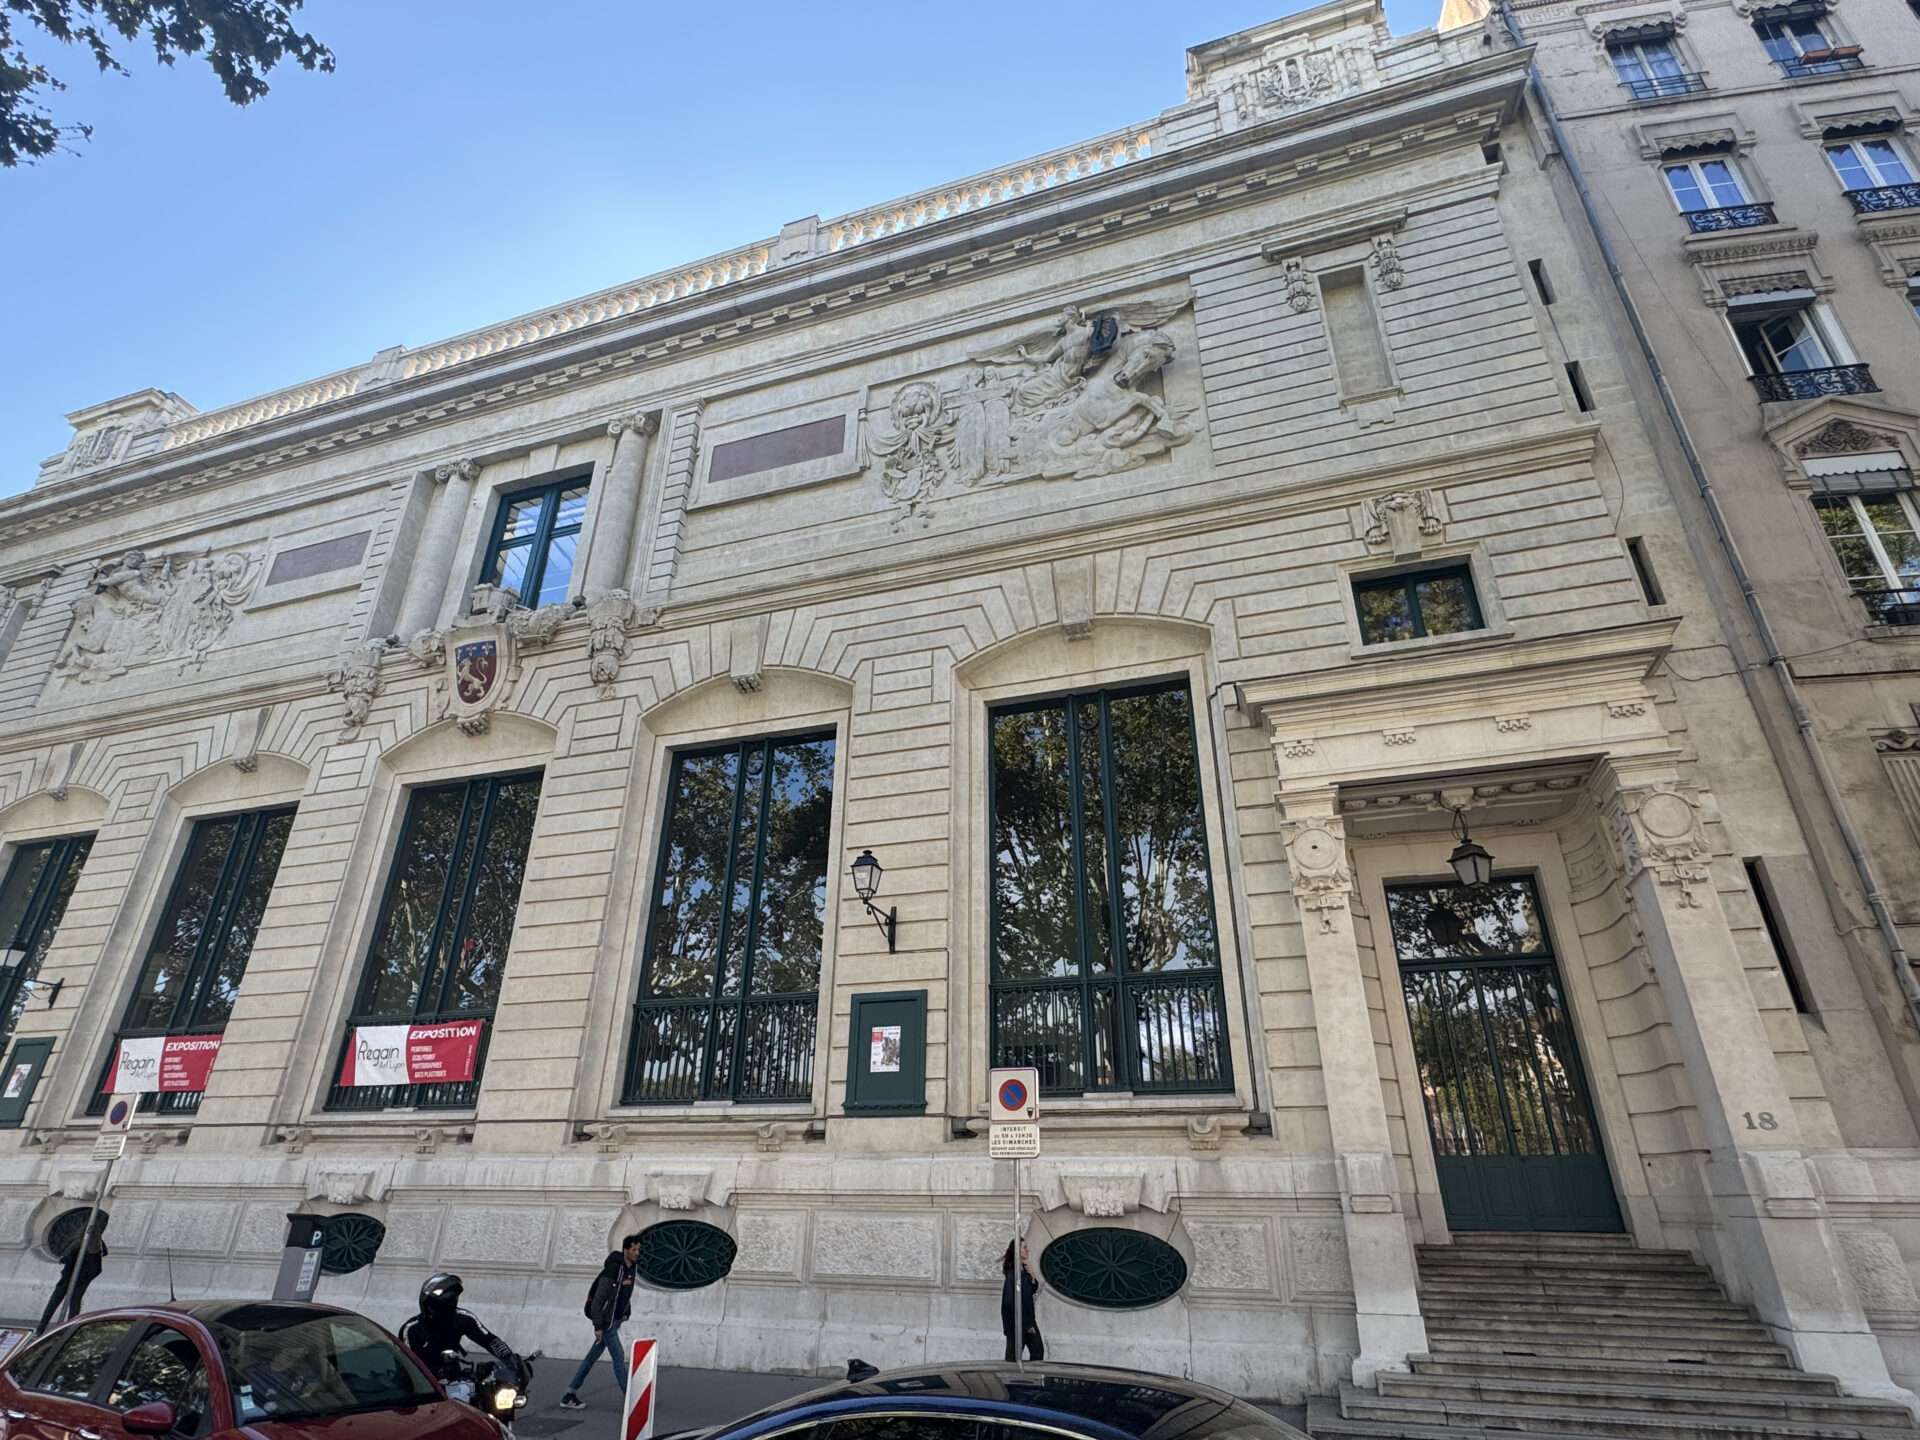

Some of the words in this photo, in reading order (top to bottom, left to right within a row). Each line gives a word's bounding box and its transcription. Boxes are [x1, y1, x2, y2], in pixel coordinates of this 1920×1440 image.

[410, 1026, 477, 1039] EXPOSITION
[165, 1040, 220, 1051] EXPOSITION
[358, 1040, 400, 1067] Regain
[120, 1051, 155, 1076] Regain
[1742, 1111, 1778, 1131] 18
[312, 1230, 322, 1246] P
